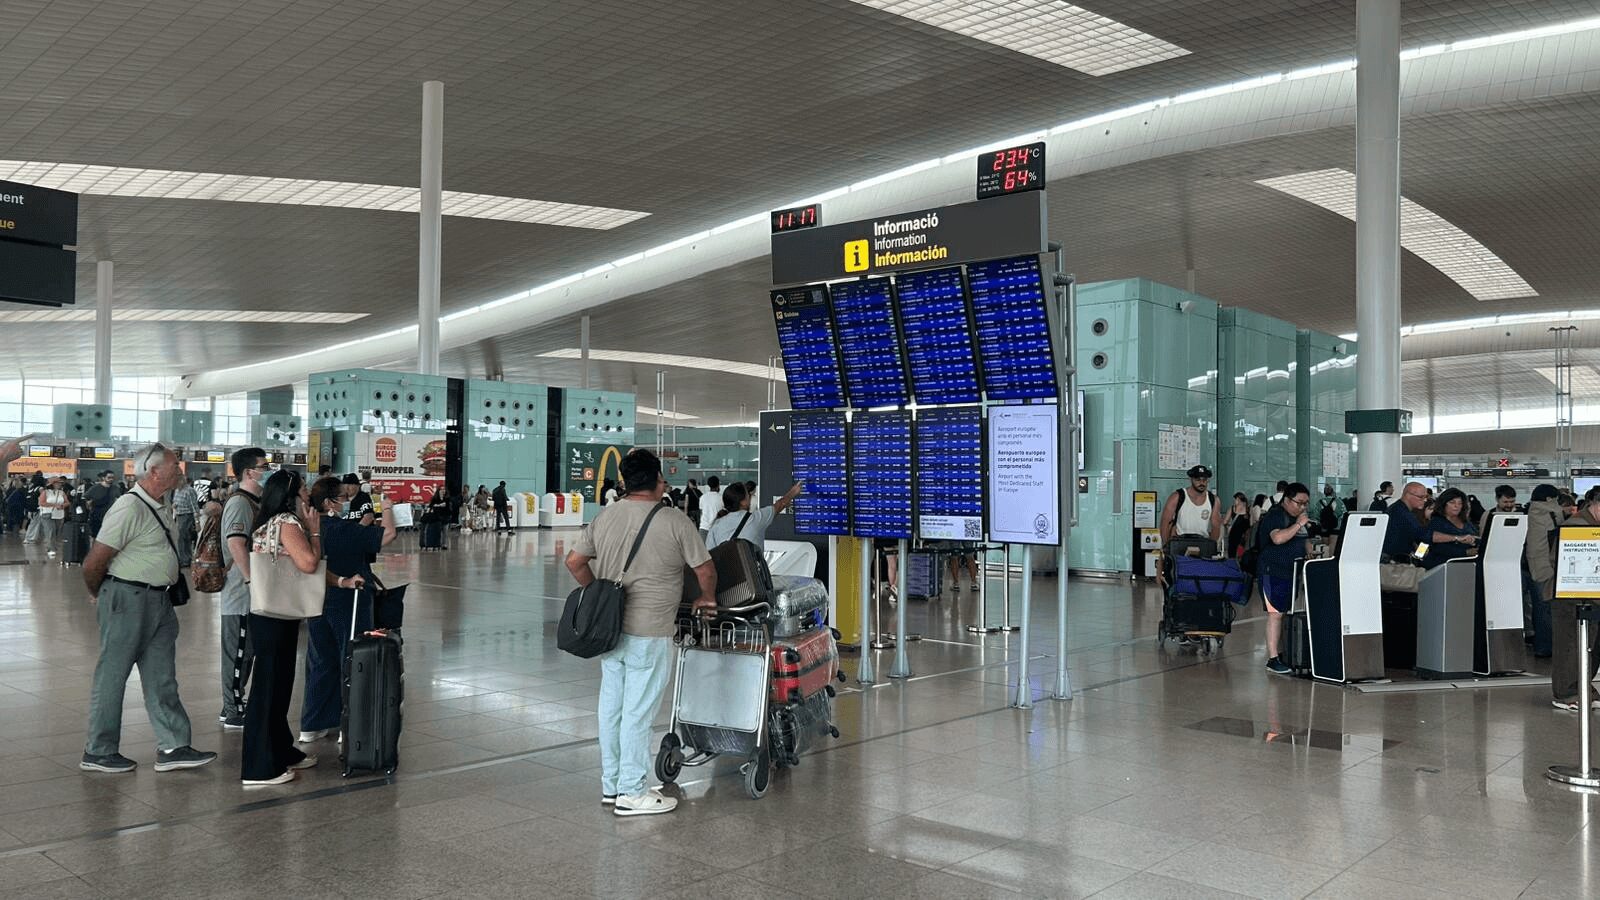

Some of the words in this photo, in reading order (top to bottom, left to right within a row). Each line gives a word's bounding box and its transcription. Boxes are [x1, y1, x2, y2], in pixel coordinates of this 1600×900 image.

[1004, 170, 1028, 190] 64
[0, 193, 24, 205] ent
[874, 212, 938, 236] Informació
[874, 233, 926, 251] Information
[875, 245, 947, 267] Información
[372, 466, 414, 474] WHOPPER
